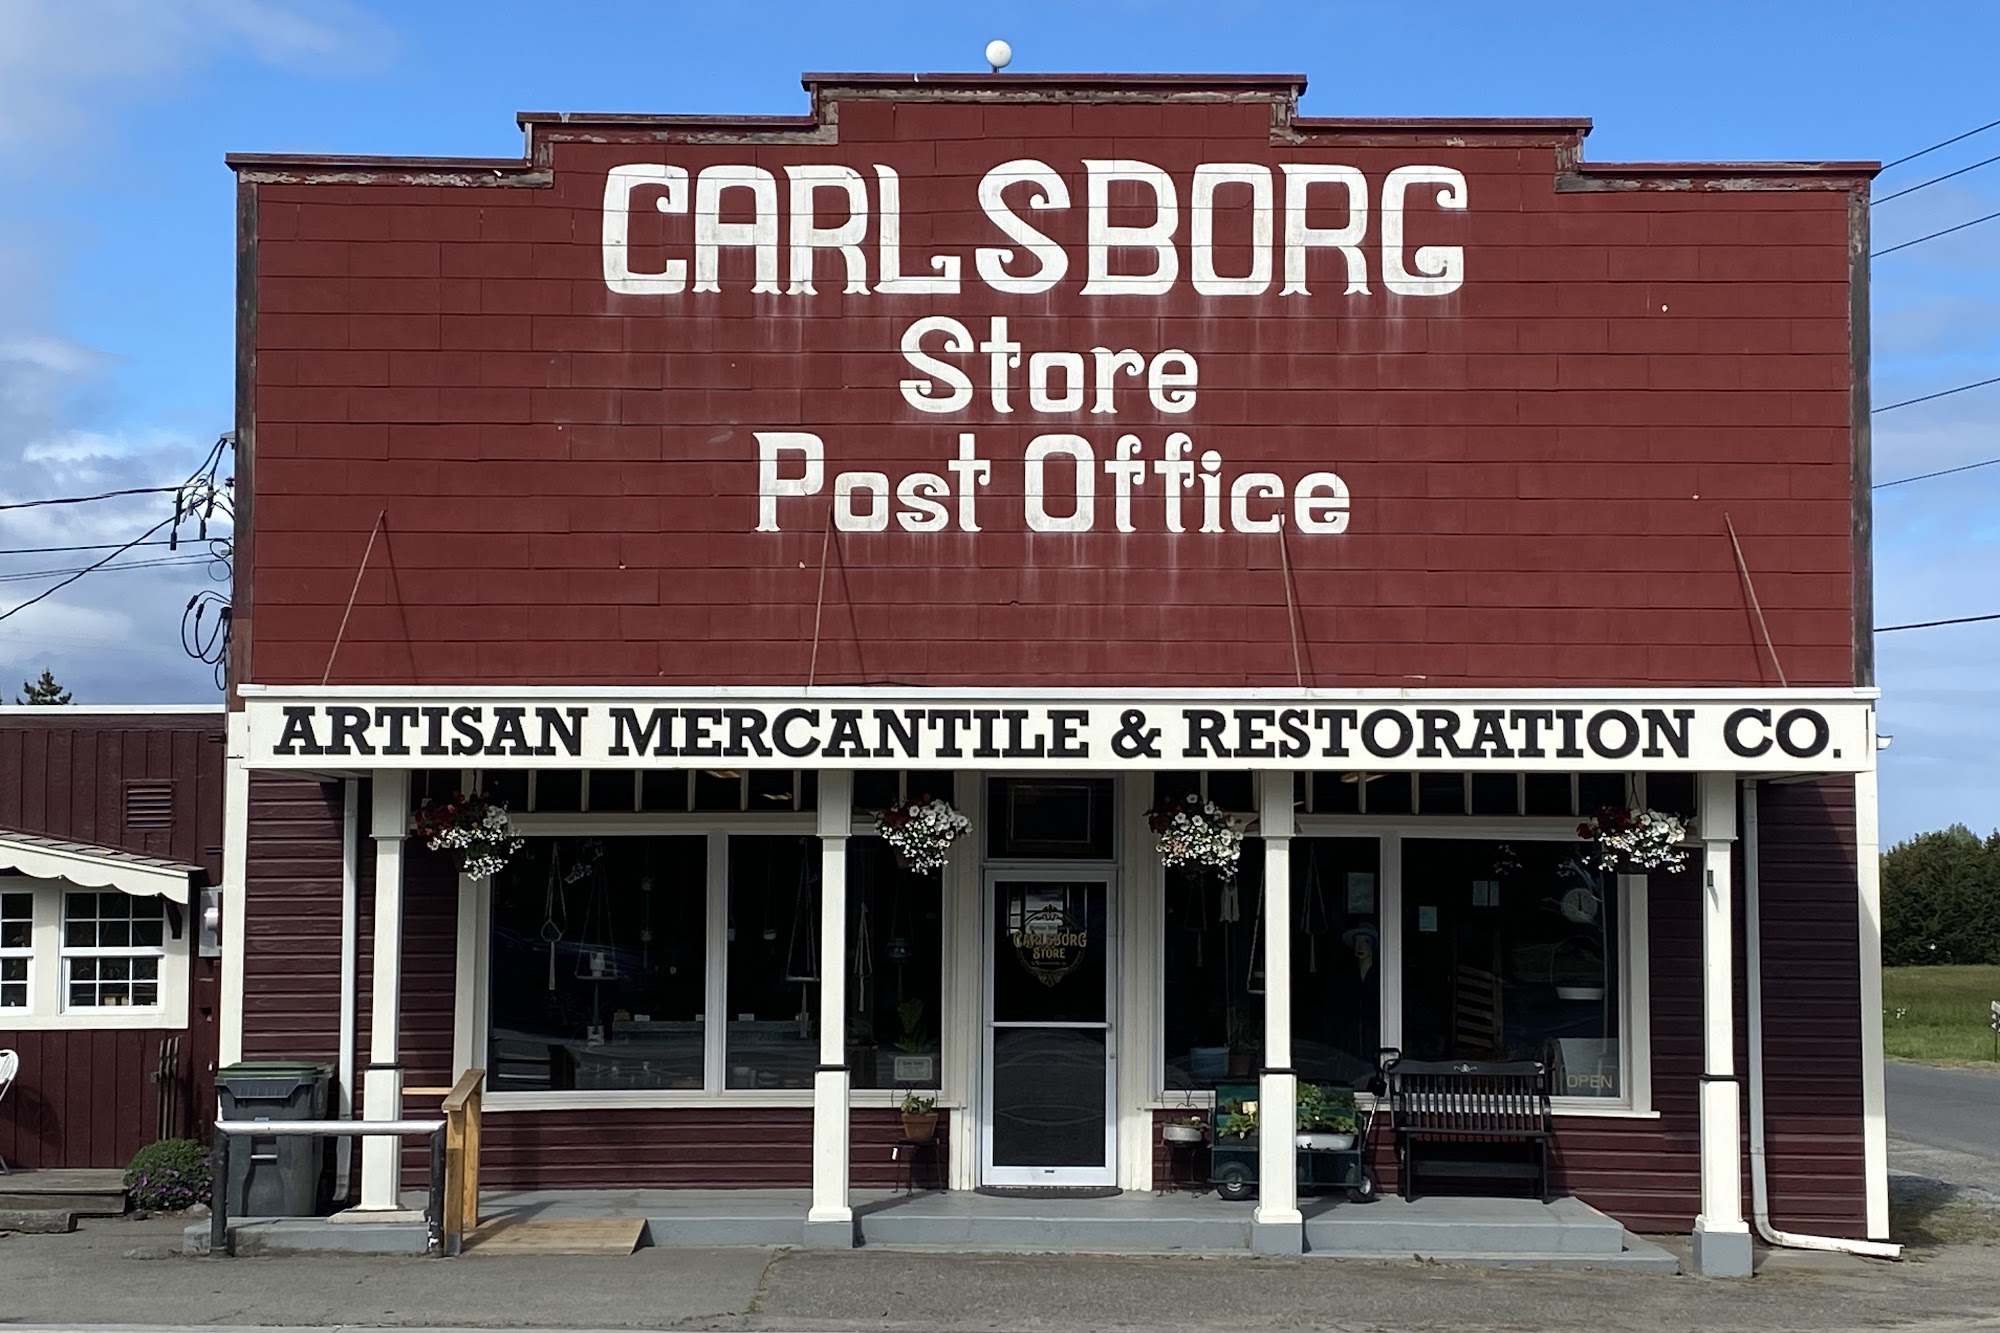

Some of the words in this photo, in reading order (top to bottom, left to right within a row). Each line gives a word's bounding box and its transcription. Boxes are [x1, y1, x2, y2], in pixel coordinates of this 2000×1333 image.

[601, 158, 1469, 298] CARLSBORG
[899, 315, 1200, 415] Store
[752, 431, 992, 534] Post
[1023, 431, 1351, 535] Office
[272, 705, 588, 756] ARTISAN
[607, 707, 1090, 759] MERCANTILE
[1110, 708, 1162, 759] &
[1182, 708, 1696, 759] RESTORATION
[1722, 707, 1842, 759] CO.
[1032, 947, 1066, 959] STORE
[1567, 1074, 1613, 1088] OPEN
